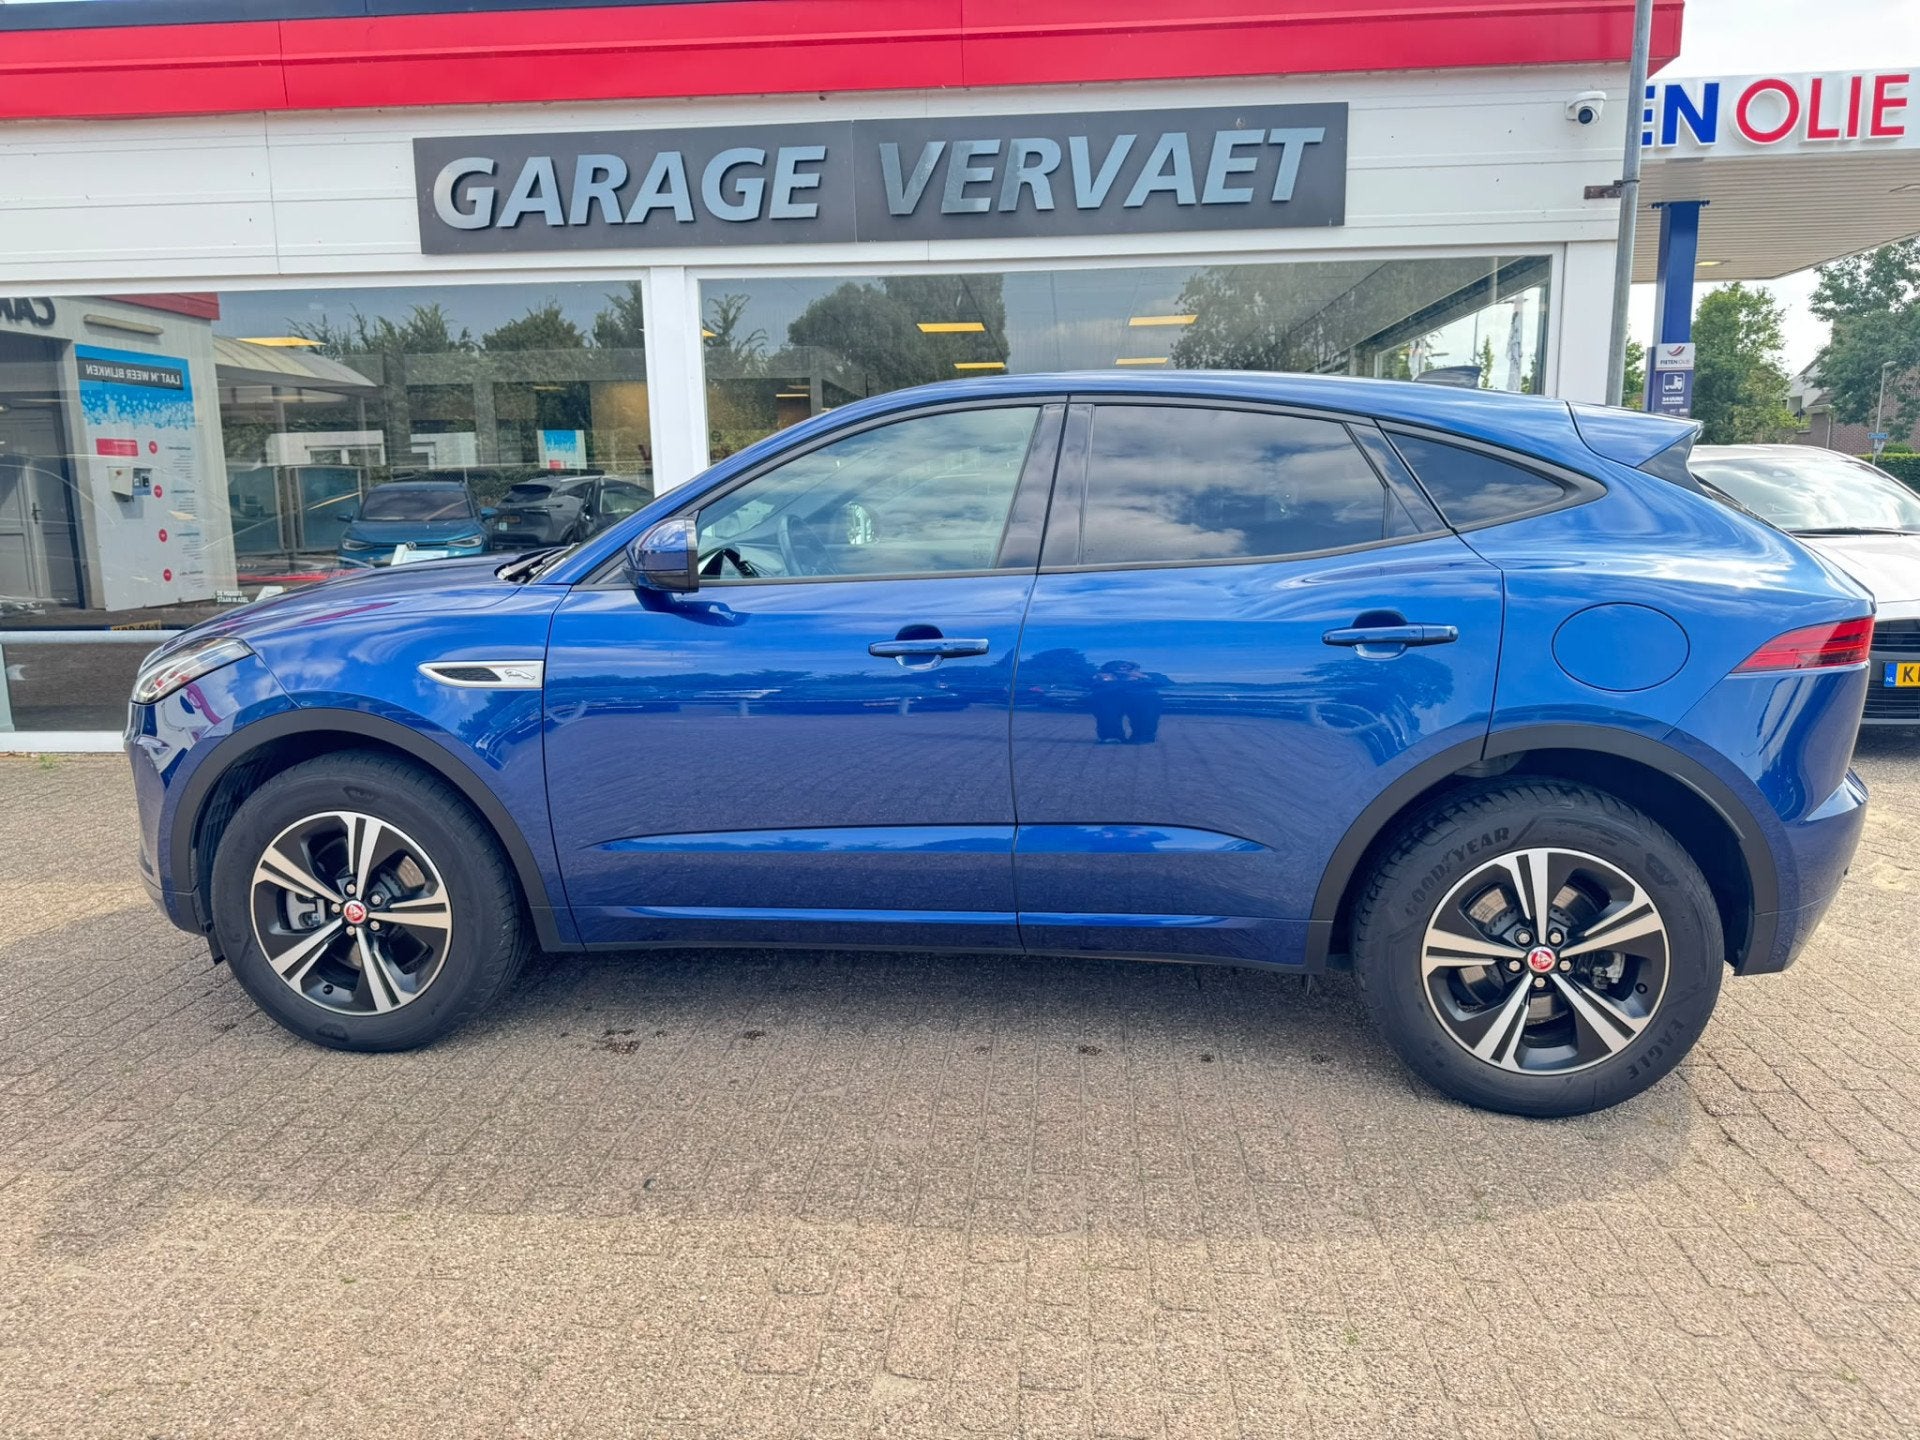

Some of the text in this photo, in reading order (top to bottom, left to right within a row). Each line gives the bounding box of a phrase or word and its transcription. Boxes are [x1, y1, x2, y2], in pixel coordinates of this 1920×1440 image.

[1735, 74, 1910, 144] OLIE
[434, 127, 1325, 229] GARAGE VERVAET
[1903, 666, 1920, 682] K
